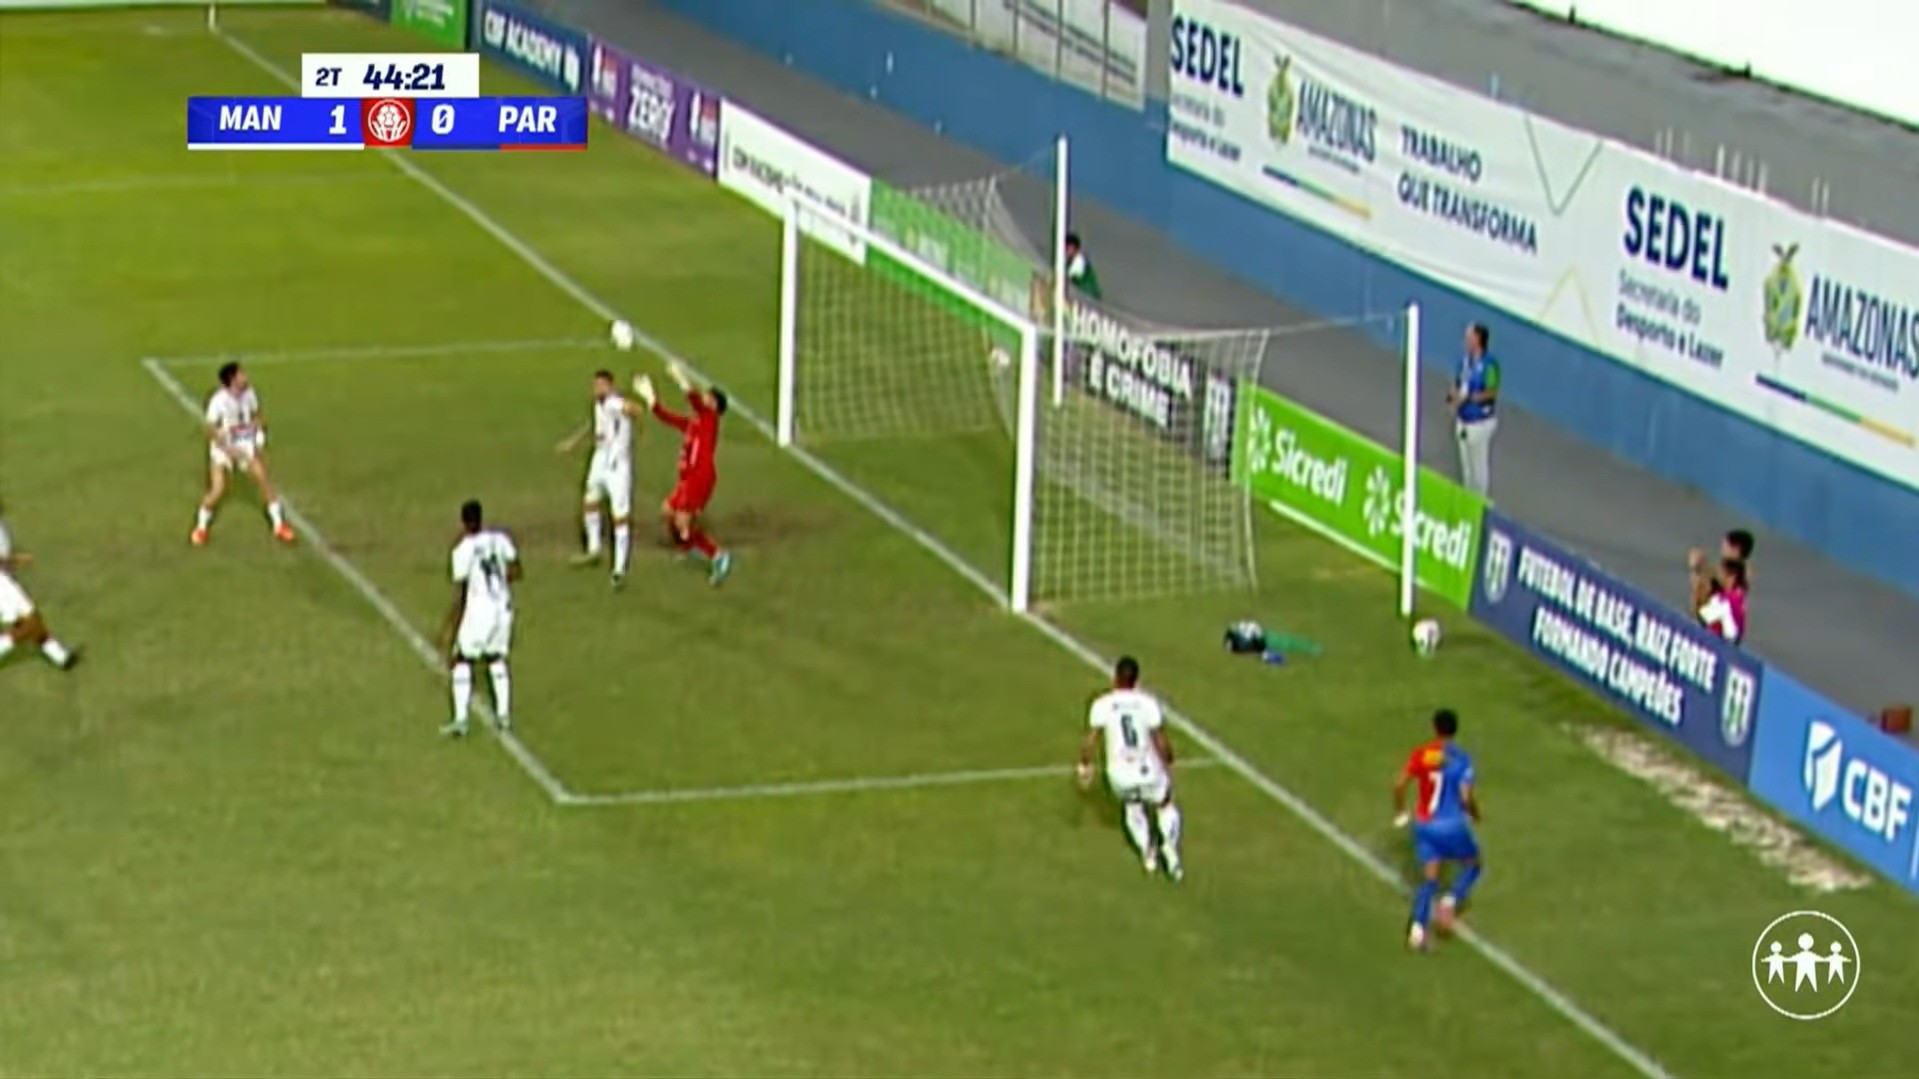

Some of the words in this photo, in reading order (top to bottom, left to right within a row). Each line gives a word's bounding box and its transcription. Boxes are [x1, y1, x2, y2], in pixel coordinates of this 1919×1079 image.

[1171, 14, 1244, 98] SEDEL
[627, 84, 675, 144] ZERO
[1299, 79, 1377, 163] AMAZONAS
[1400, 126, 1482, 183] TRABALHO
[1397, 173, 1429, 212] QUE
[1431, 179, 1538, 256] TRANSFORMA
[1624, 184, 1729, 292] SEDEL
[1070, 301, 1193, 400] HOMOFOBIA
[1616, 301, 1676, 350] Desporto
[1688, 330, 1724, 370] Lazer
[1106, 363, 1171, 428] CRIME
[1272, 428, 1348, 506] Sicredi
[1390, 490, 1472, 571] Scredi
[1517, 546, 1577, 610] FUTEBOL
[1576, 575, 1596, 623] DE
[1595, 590, 1634, 647] BASE,
[1636, 610, 1670, 667] RAIZ
[1669, 631, 1718, 694] FORTE
[1533, 605, 1609, 680] FORMANDO
[1608, 648, 1683, 728] CAMPEÕES
[1121, 714, 1137, 748] 6
[1428, 772, 1443, 814] 7
[1842, 757, 1912, 842] CBF
